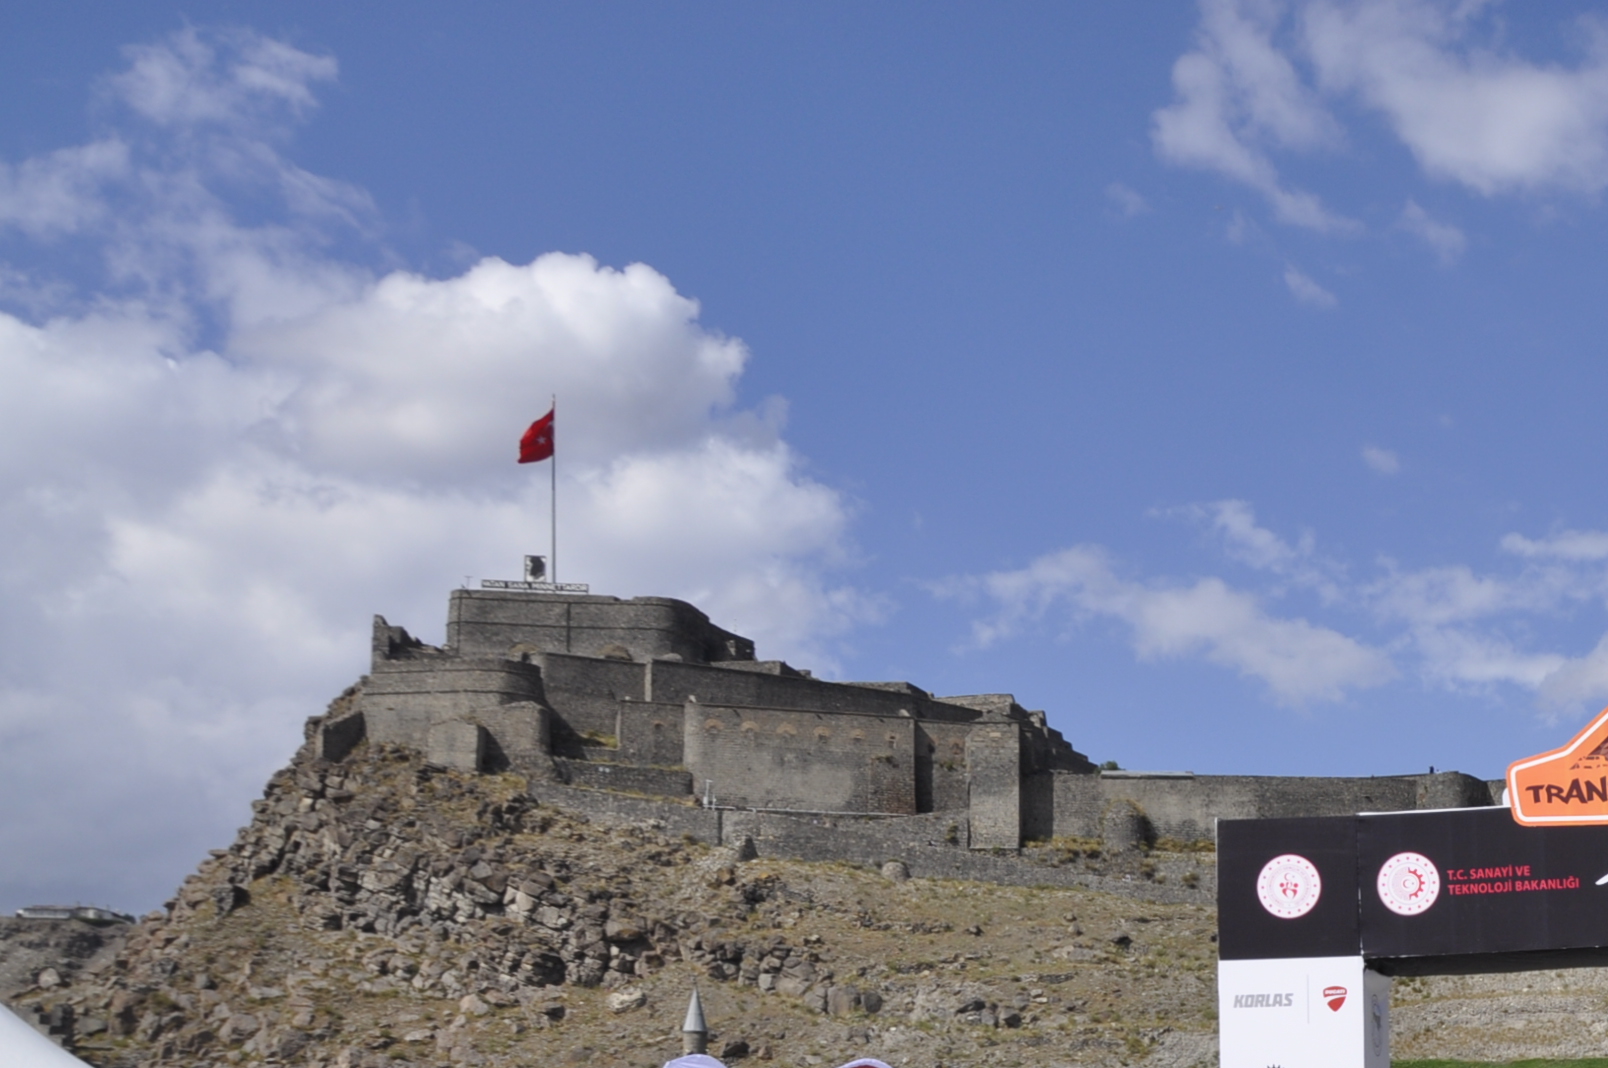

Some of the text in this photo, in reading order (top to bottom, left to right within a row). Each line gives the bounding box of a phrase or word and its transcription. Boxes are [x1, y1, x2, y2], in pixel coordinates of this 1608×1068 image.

[1447, 864, 1531, 880] T.C. SANAYİ VE
[1447, 876, 1580, 895] TEKNOLOJİ BAKANLIĞI
[1324, 988, 1346, 996] DUCATI
[1233, 993, 1293, 1008] KORLAS
